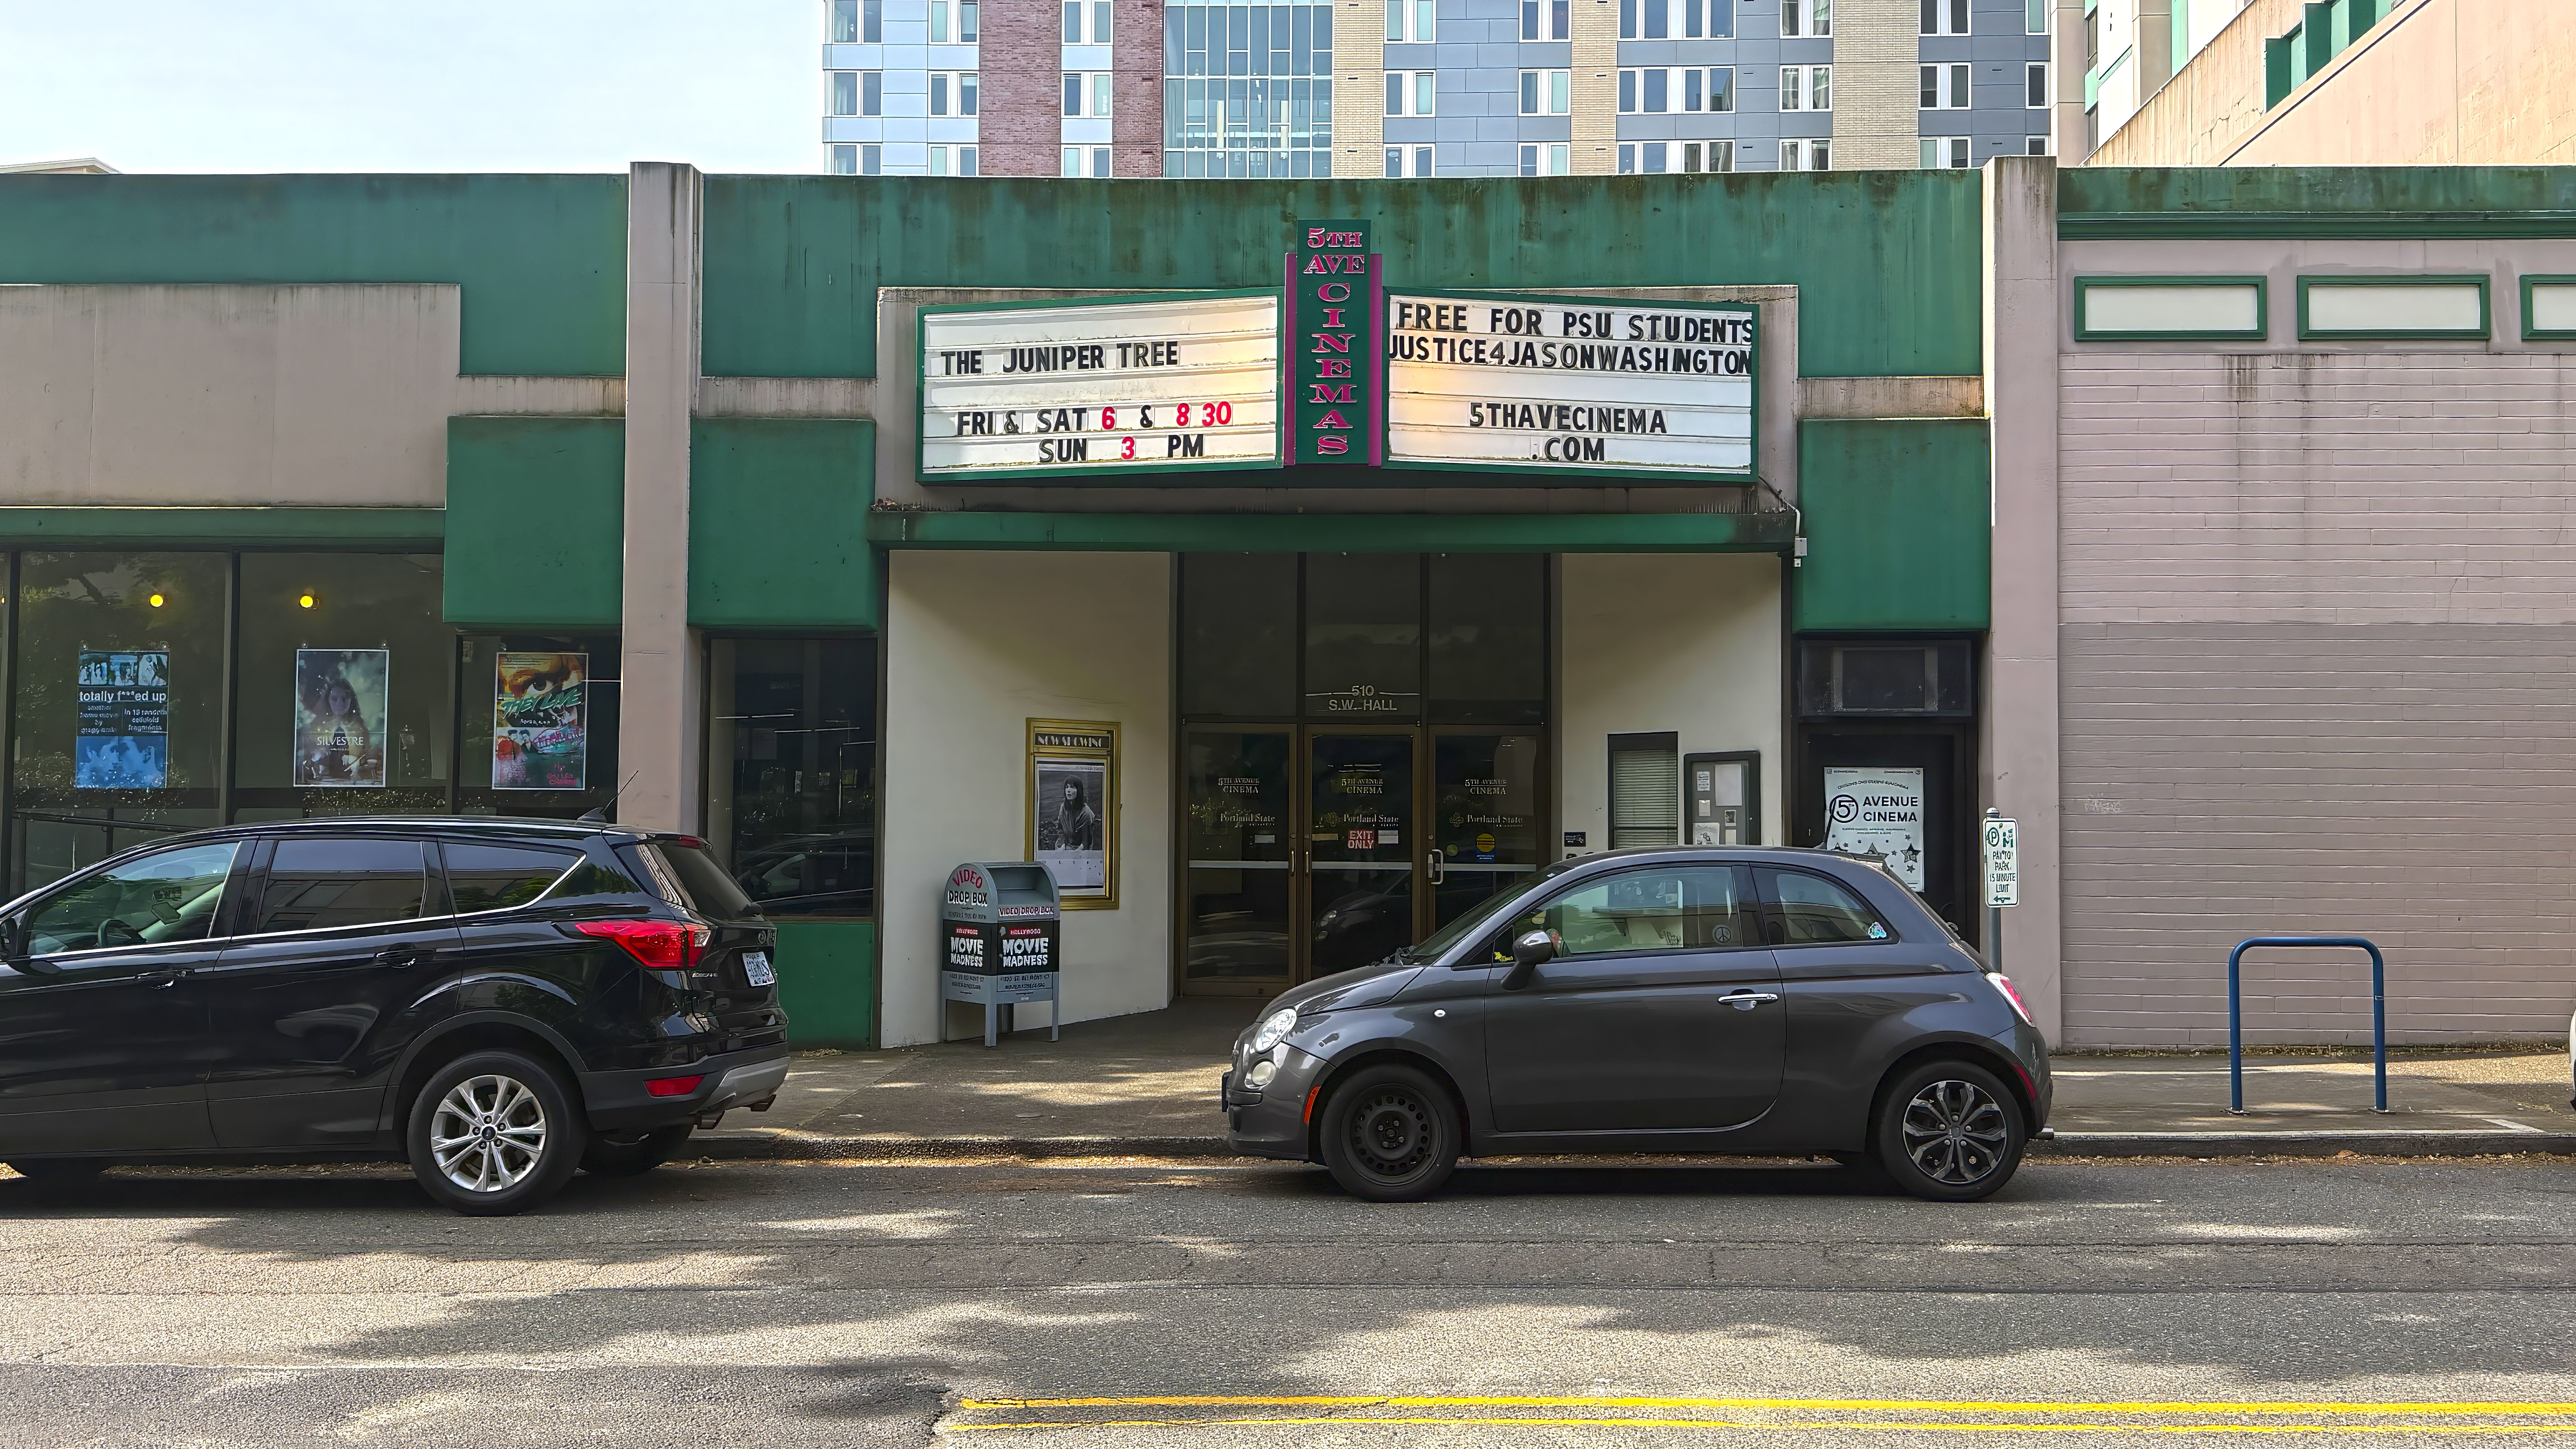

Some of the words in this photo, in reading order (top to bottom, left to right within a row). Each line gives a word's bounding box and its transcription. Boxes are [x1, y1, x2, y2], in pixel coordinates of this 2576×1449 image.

[1307, 227, 1362, 248] 5TH
[1303, 254, 1365, 274] AVE
[1398, 303, 1467, 331] FREE
[1490, 308, 1543, 335] FOR
[1563, 311, 1611, 338] PSU
[1628, 314, 1752, 343] STUDENTS
[941, 350, 982, 375] THE
[1003, 345, 1104, 373] JUNIPER
[1116, 341, 1178, 368] TREE
[1309, 282, 1357, 455] CINEMAS
[957, 411, 993, 435] FRI
[1004, 410, 1019, 434] &
[1037, 407, 1087, 433] SAT
[1101, 406, 1116, 430] 6
[1140, 405, 1153, 428] &
[1176, 403, 1189, 426] 8
[1201, 401, 1231, 427] 30
[1469, 402, 1667, 433] 5THAVECINEMA
[1039, 438, 1086, 463] SUN
[1121, 436, 1135, 460] 3
[1168, 433, 1204, 458] PM
[1532, 436, 1605, 461] .COM
[79, 690, 114, 704] totally
[152, 692, 166, 703] up
[1352, 685, 1375, 696] 510
[1363, 699, 1397, 711] HALL
[1863, 796, 1918, 807] AVENUE
[1863, 811, 1918, 822] CINEMA
[1349, 830, 1373, 840] EXIT
[1347, 840, 1374, 849] ONLY
[952, 869, 983, 889] VIDEO
[948, 890, 970, 906] DROP
[971, 891, 988, 906] BOX
[998, 907, 1019, 917] VIDEO
[1020, 906, 1039, 916] DROP
[950, 937, 984, 955] MOVIE
[1003, 937, 1049, 956] MOVIE
[950, 952, 983, 967] MADNESS
[1003, 954, 1048, 967] MADNESS
